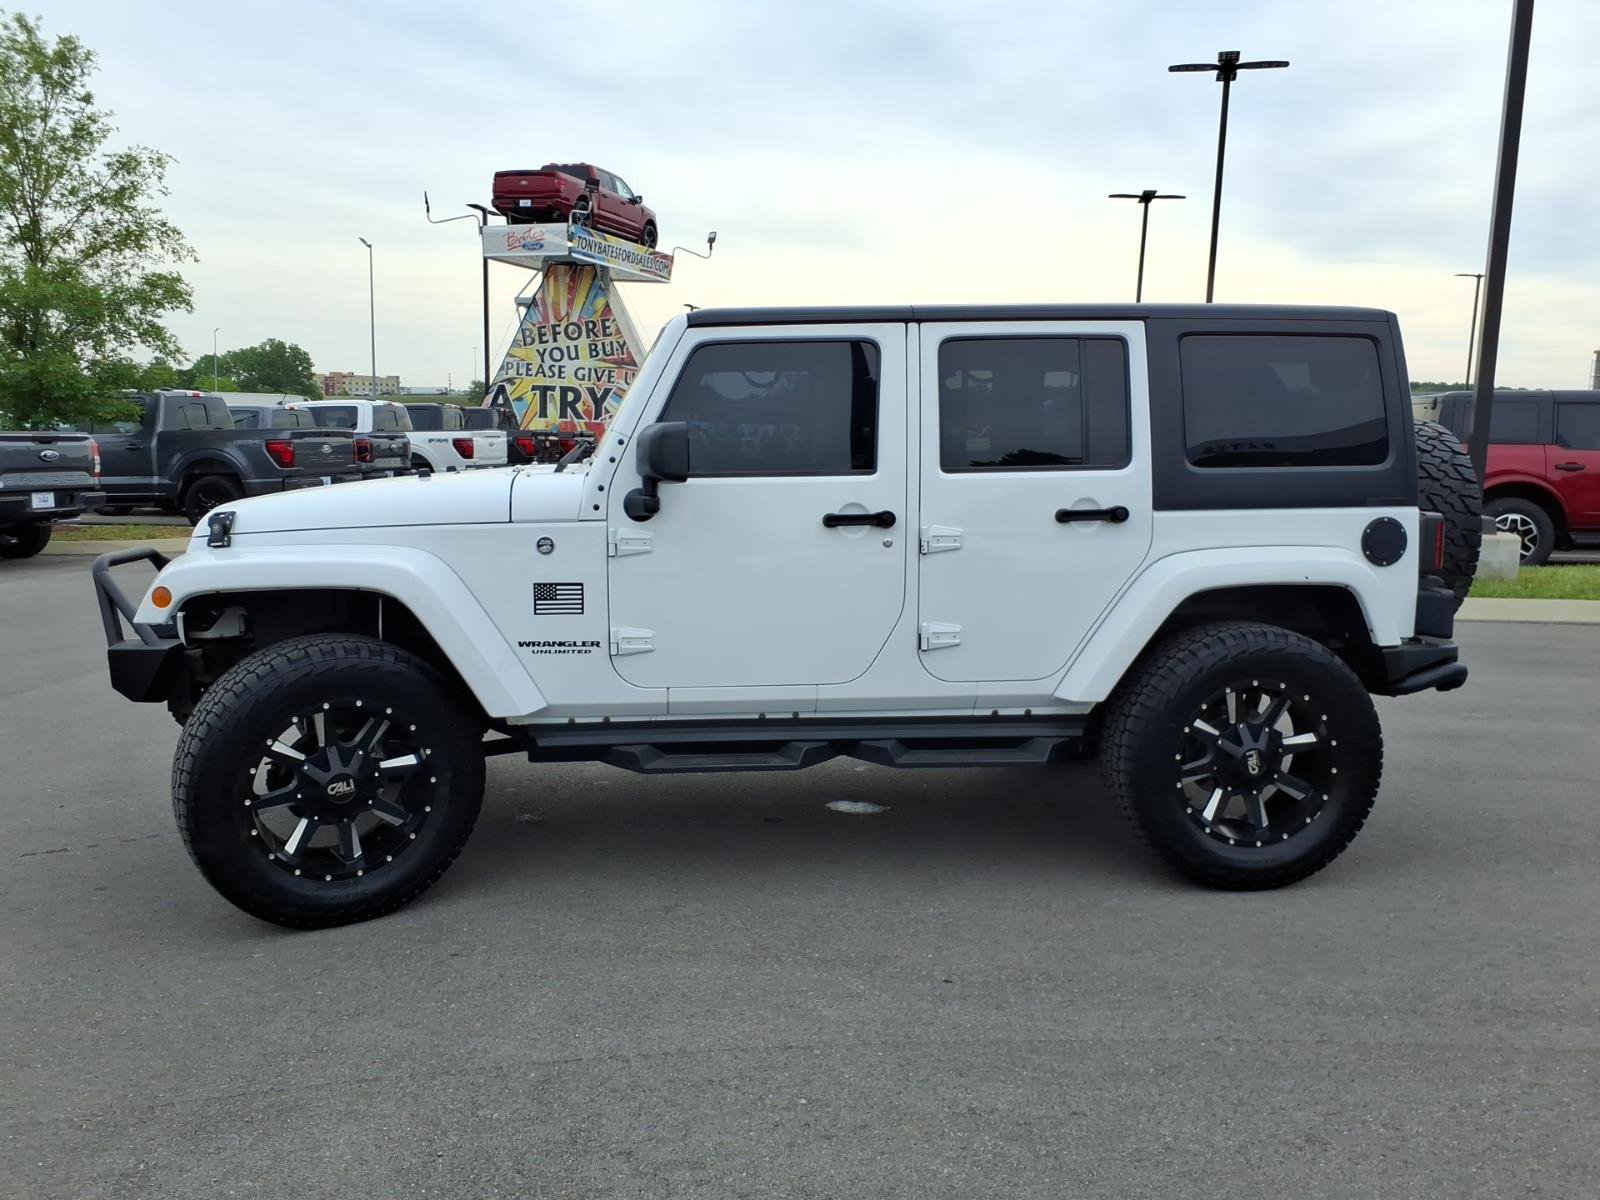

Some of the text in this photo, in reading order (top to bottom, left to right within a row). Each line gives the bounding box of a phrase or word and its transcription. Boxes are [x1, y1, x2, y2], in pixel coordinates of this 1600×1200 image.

[503, 227, 546, 247] Bates
[577, 235, 669, 274] TONYBATESFORDSALES.COM
[521, 318, 613, 347] BEFORE
[537, 340, 628, 364] YOU BUY
[505, 361, 636, 386] PLEASE GIVE U
[531, 384, 613, 421] TRY
[518, 640, 601, 648] WRANGLER
[327, 779, 355, 795] CALI
